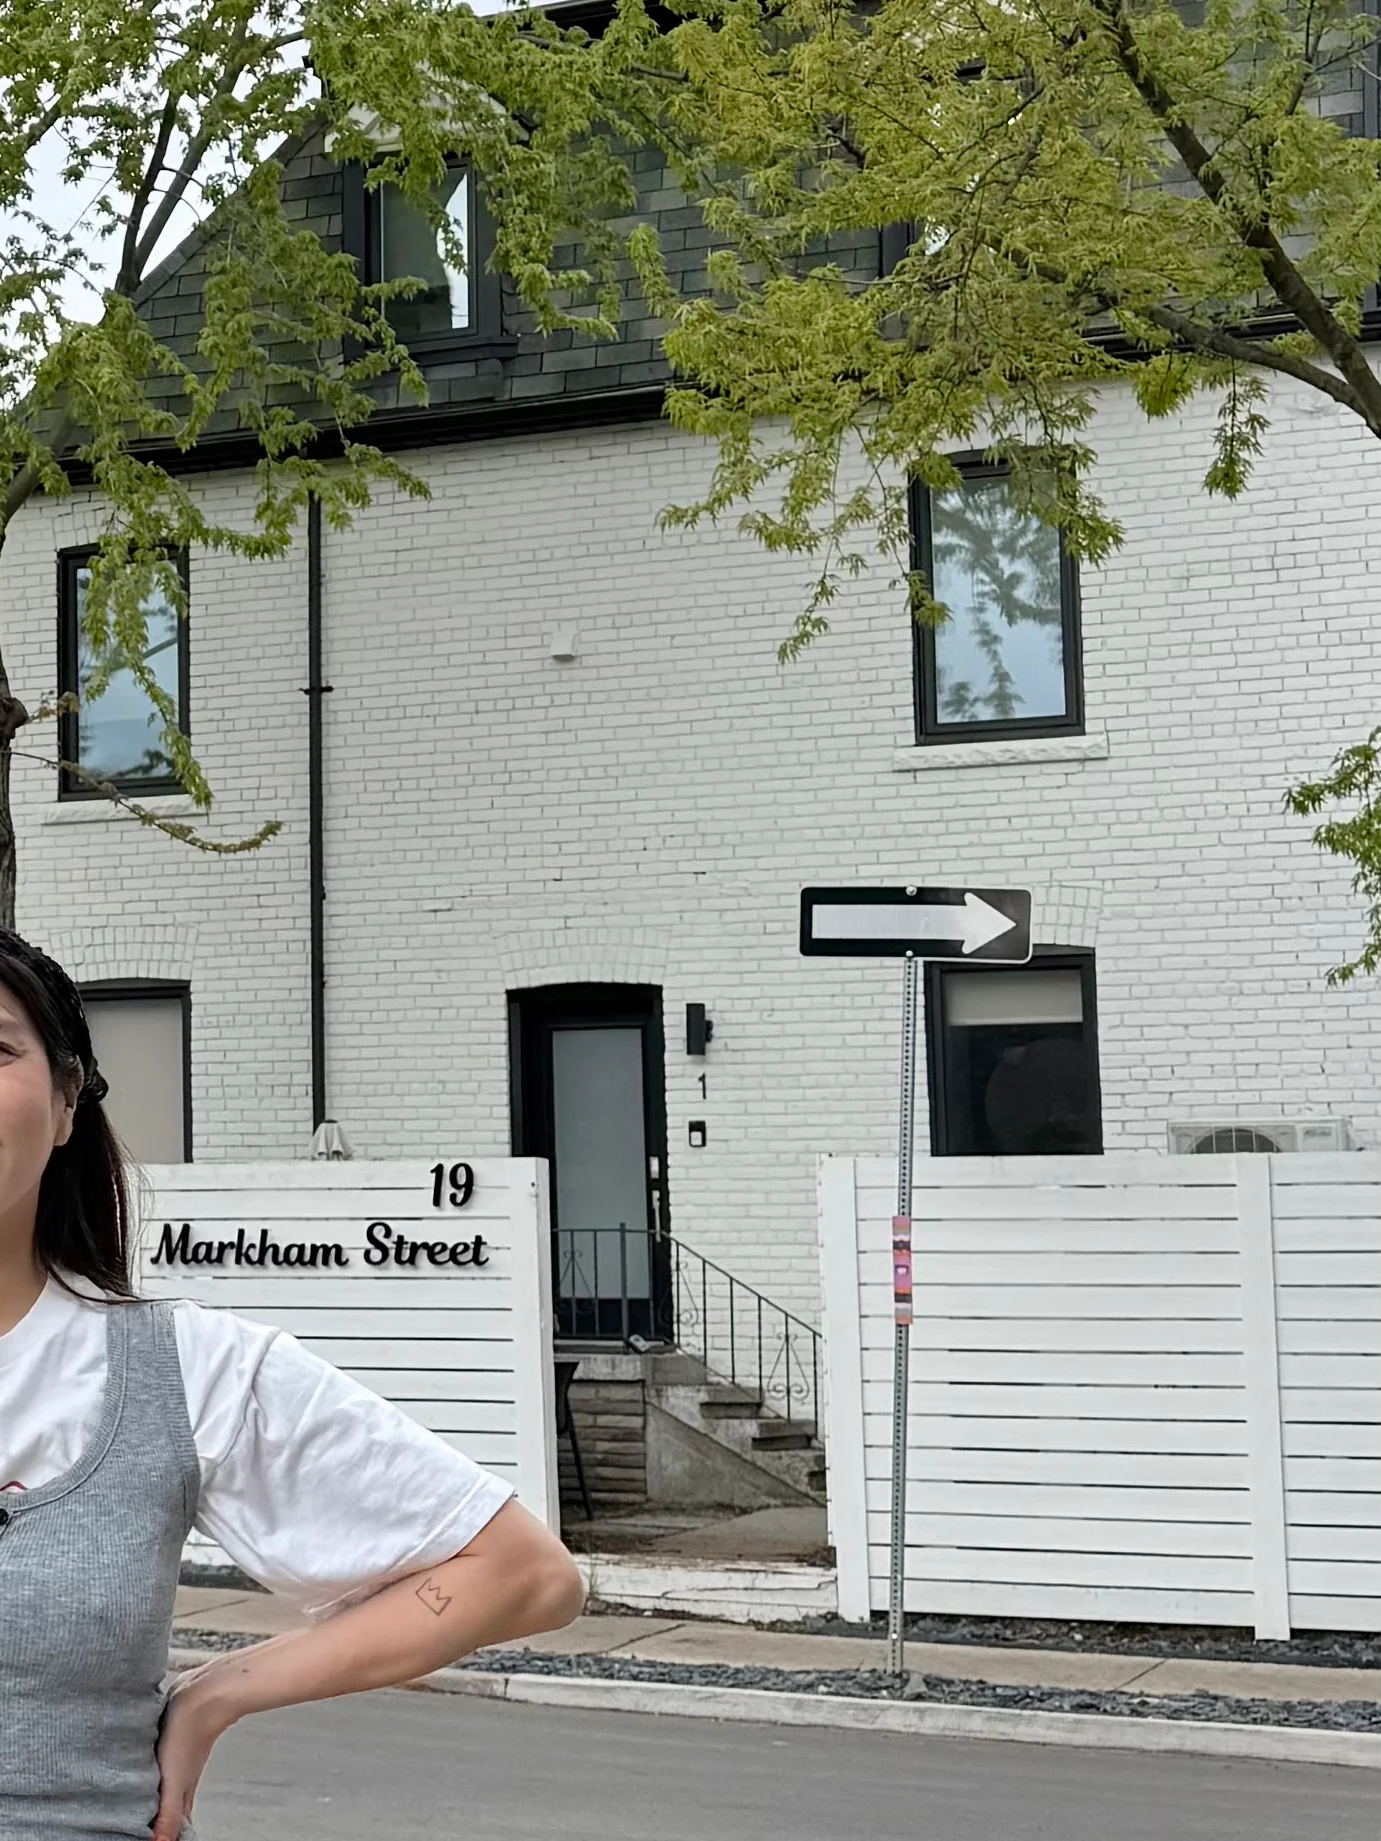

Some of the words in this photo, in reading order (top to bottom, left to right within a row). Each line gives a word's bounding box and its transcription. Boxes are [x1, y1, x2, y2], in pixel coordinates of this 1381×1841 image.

[698, 1072, 707, 1101] 1
[429, 1162, 475, 1208] 19
[150, 1222, 350, 1267] Markham
[363, 1221, 490, 1267] Street
